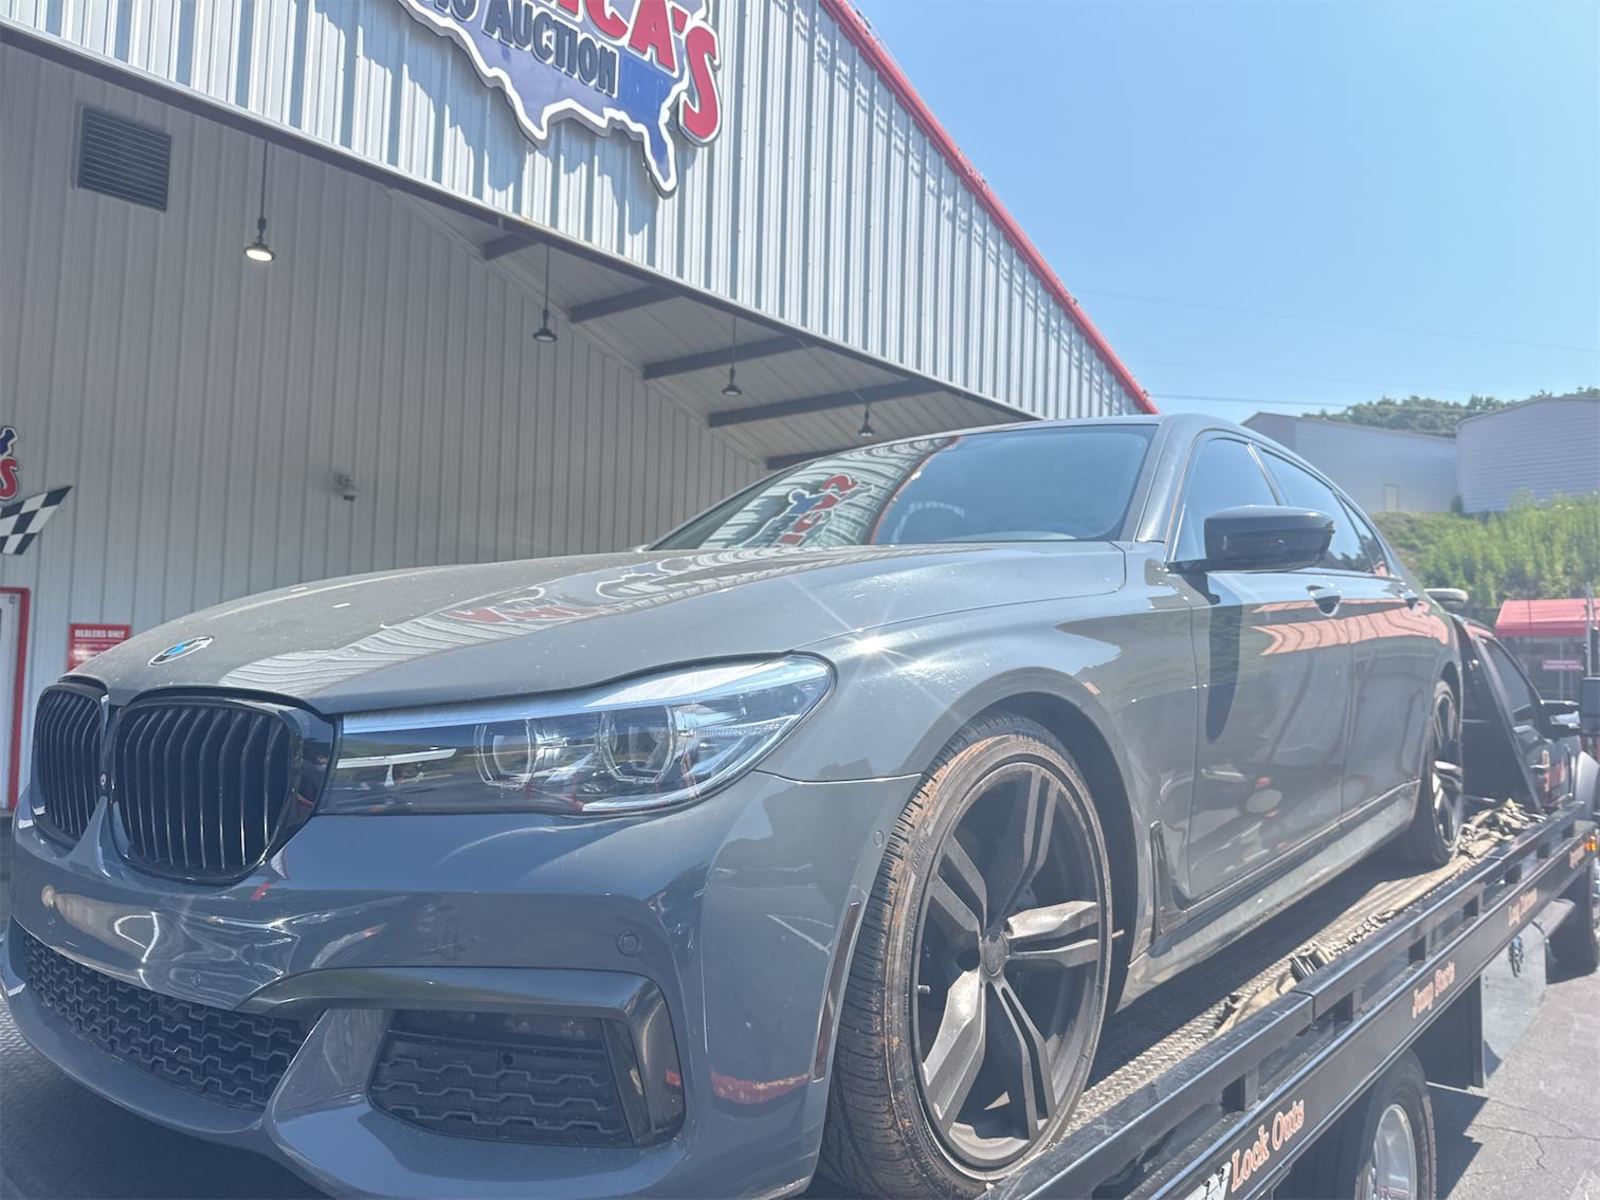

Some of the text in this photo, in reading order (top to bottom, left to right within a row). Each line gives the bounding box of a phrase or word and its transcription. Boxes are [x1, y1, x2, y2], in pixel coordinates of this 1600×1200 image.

[481, 0, 618, 98] AUCTION
[74, 629, 125, 639] DEALERS ONLY
[1231, 1099, 1305, 1193] Lock Outs
